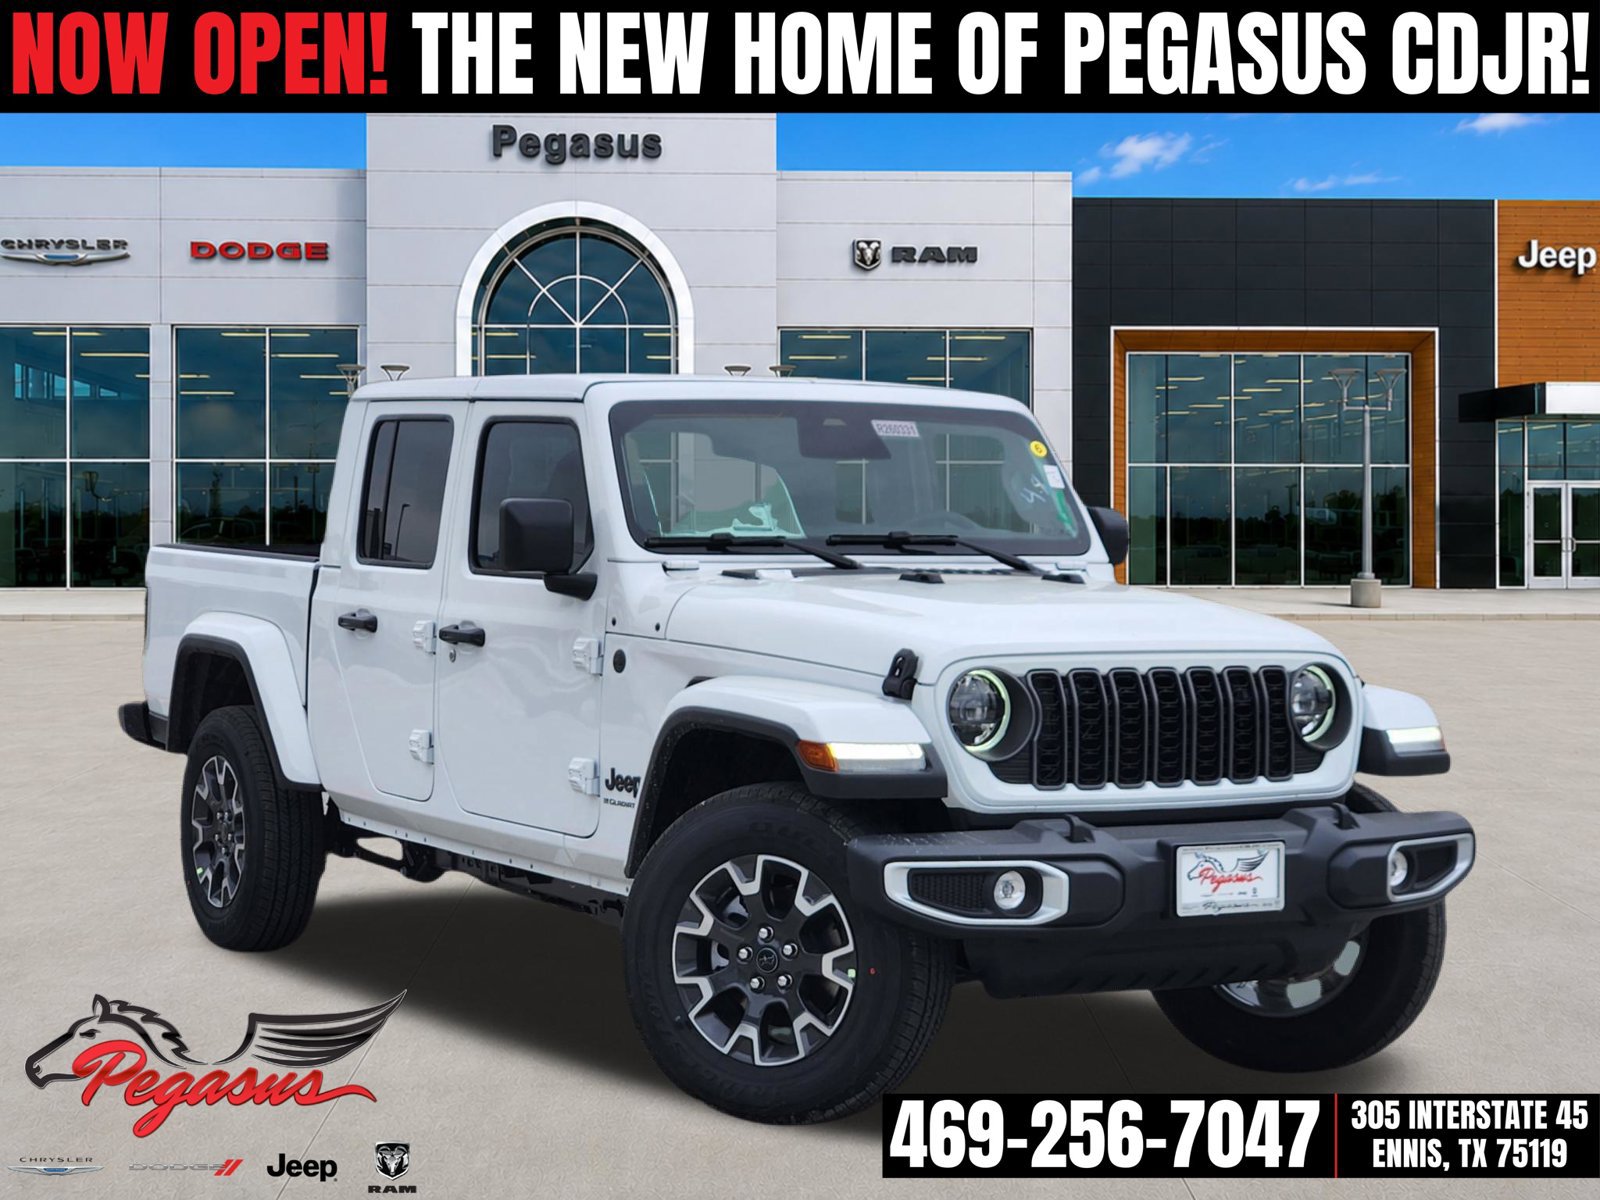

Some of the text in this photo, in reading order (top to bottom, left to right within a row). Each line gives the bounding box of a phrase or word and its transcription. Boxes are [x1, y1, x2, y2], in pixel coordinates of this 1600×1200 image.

[492, 124, 663, 167] Pegasus
[0, 239, 129, 251] CHRYSLER
[190, 241, 328, 260] DODGE
[891, 246, 978, 264] RAM
[1517, 239, 1597, 276] Jeep
[605, 767, 641, 798] Jeep
[1200, 866, 1263, 893] Pegasus
